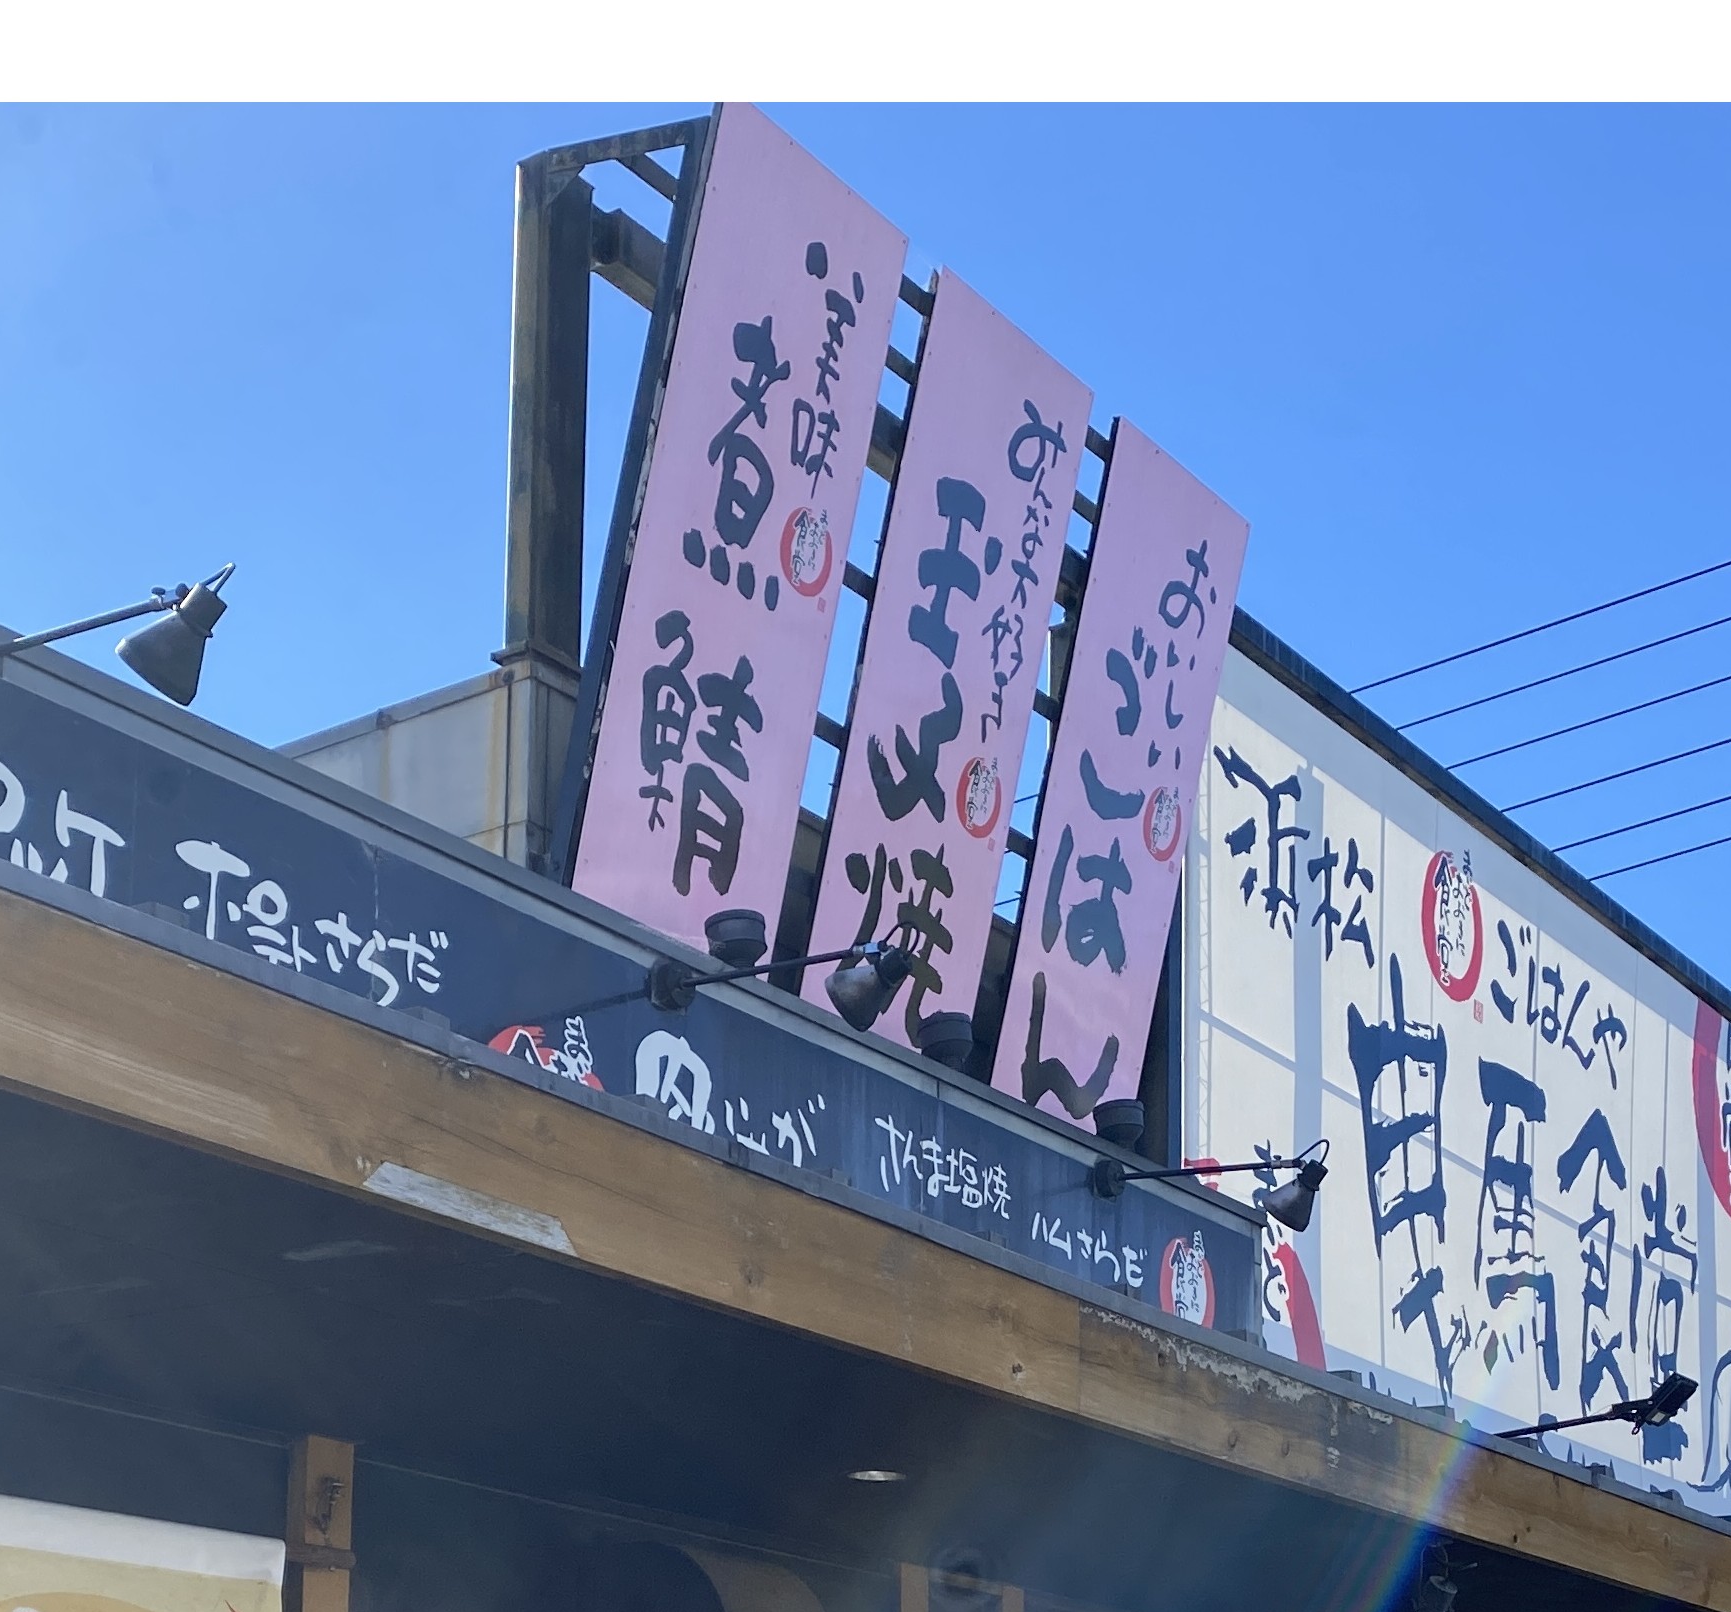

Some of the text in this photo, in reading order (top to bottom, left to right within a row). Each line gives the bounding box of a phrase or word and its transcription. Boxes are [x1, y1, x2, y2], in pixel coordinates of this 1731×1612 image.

[1021, 624, 1156, 1119] ごはん
[1213, 745, 1376, 970] 浜松
[1490, 915, 1628, 1091] ごはんや
[1033, 1211, 1145, 1289] ハムさらだ
